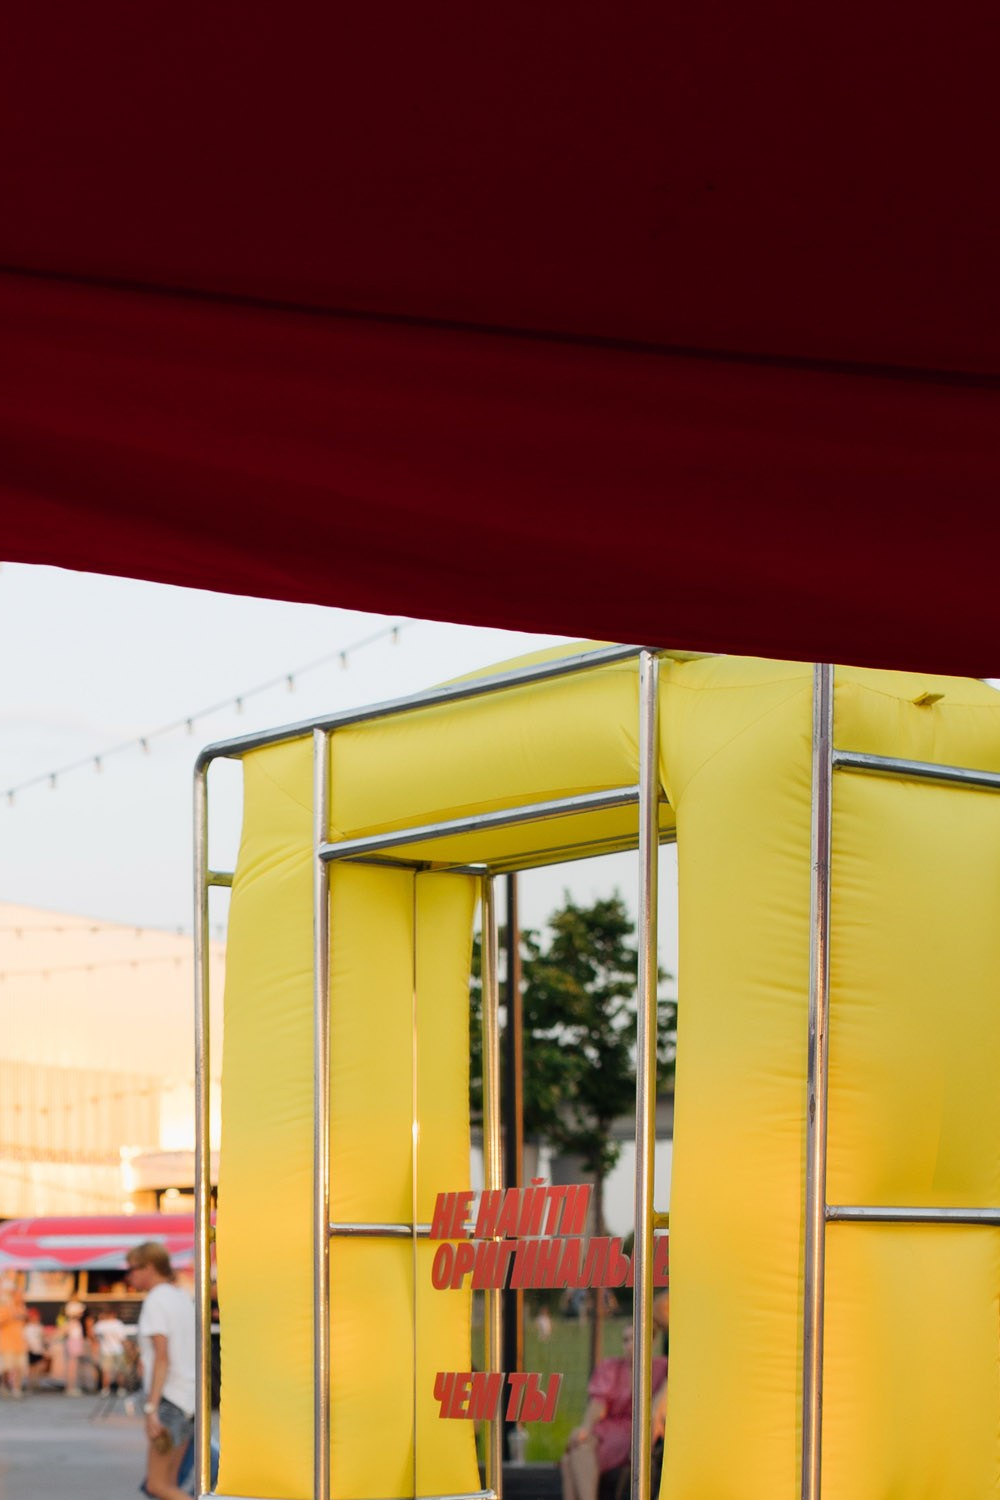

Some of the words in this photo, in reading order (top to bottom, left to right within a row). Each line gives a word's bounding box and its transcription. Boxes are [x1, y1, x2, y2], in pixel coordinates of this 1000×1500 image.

[429, 1191, 475, 1240] НЕ
[474, 1177, 593, 1239] НАЙТИ
[433, 1371, 504, 1421] ЧЕМ
[505, 1372, 563, 1422] ТЫ
